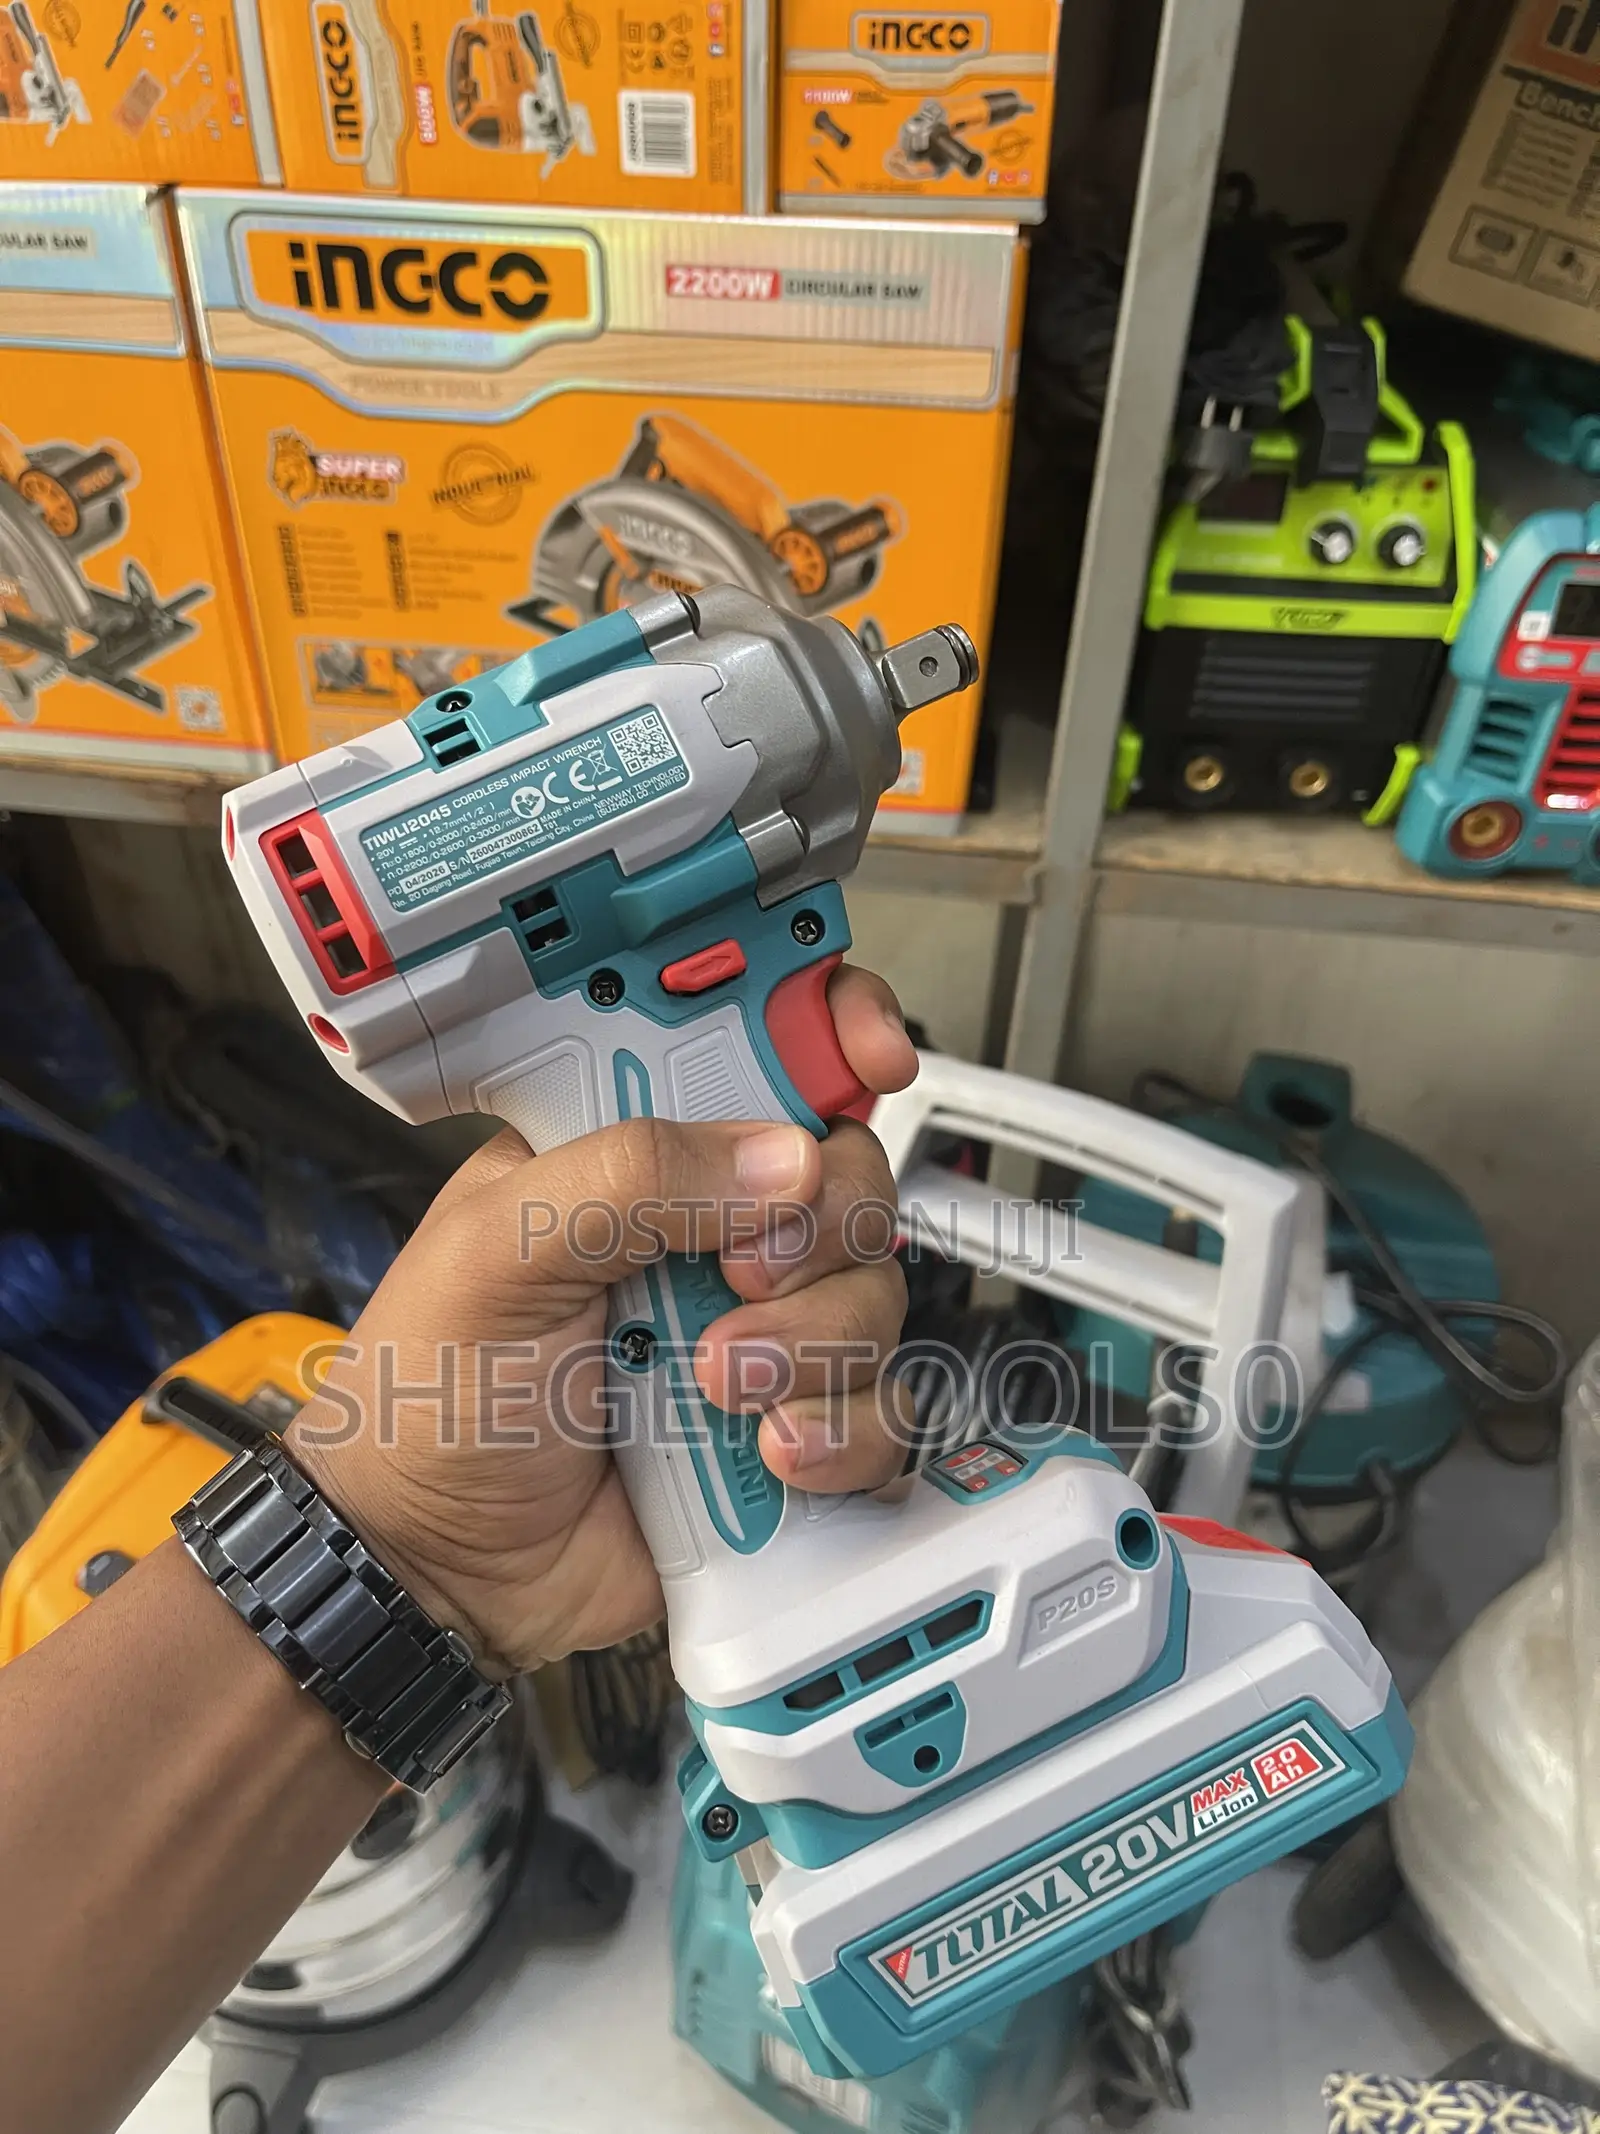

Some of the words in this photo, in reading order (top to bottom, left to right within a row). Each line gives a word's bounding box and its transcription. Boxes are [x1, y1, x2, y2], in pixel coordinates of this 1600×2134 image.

[669, 268, 774, 299] 2200W
[362, 802, 451, 852] TIWLI2045
[451, 776, 509, 809] CORDLESS
[509, 757, 552, 783] IMPACT
[552, 735, 602, 765] WRENCH
[539, 808, 563, 824] MADE
[562, 804, 572, 813] IN
[571, 792, 597, 809] CHINA
[593, 787, 633, 810] NEWWAY
[633, 763, 685, 792] TECHNOLOGY
[596, 794, 636, 818] (SUZHOU)
[654, 771, 686, 791] LIMITED
[376, 846, 396, 860] 20V
[404, 864, 446, 889] 04/2026
[448, 854, 470, 871] S/N
[469, 822, 540, 861] 260047300862
[1037, 1576, 1118, 1631] P20S
[1261, 1746, 1297, 1776] 2.0
[1271, 1763, 1304, 1791] Ah
[1192, 1769, 1248, 1813] MAX
[1081, 1799, 1188, 1894] 20V
